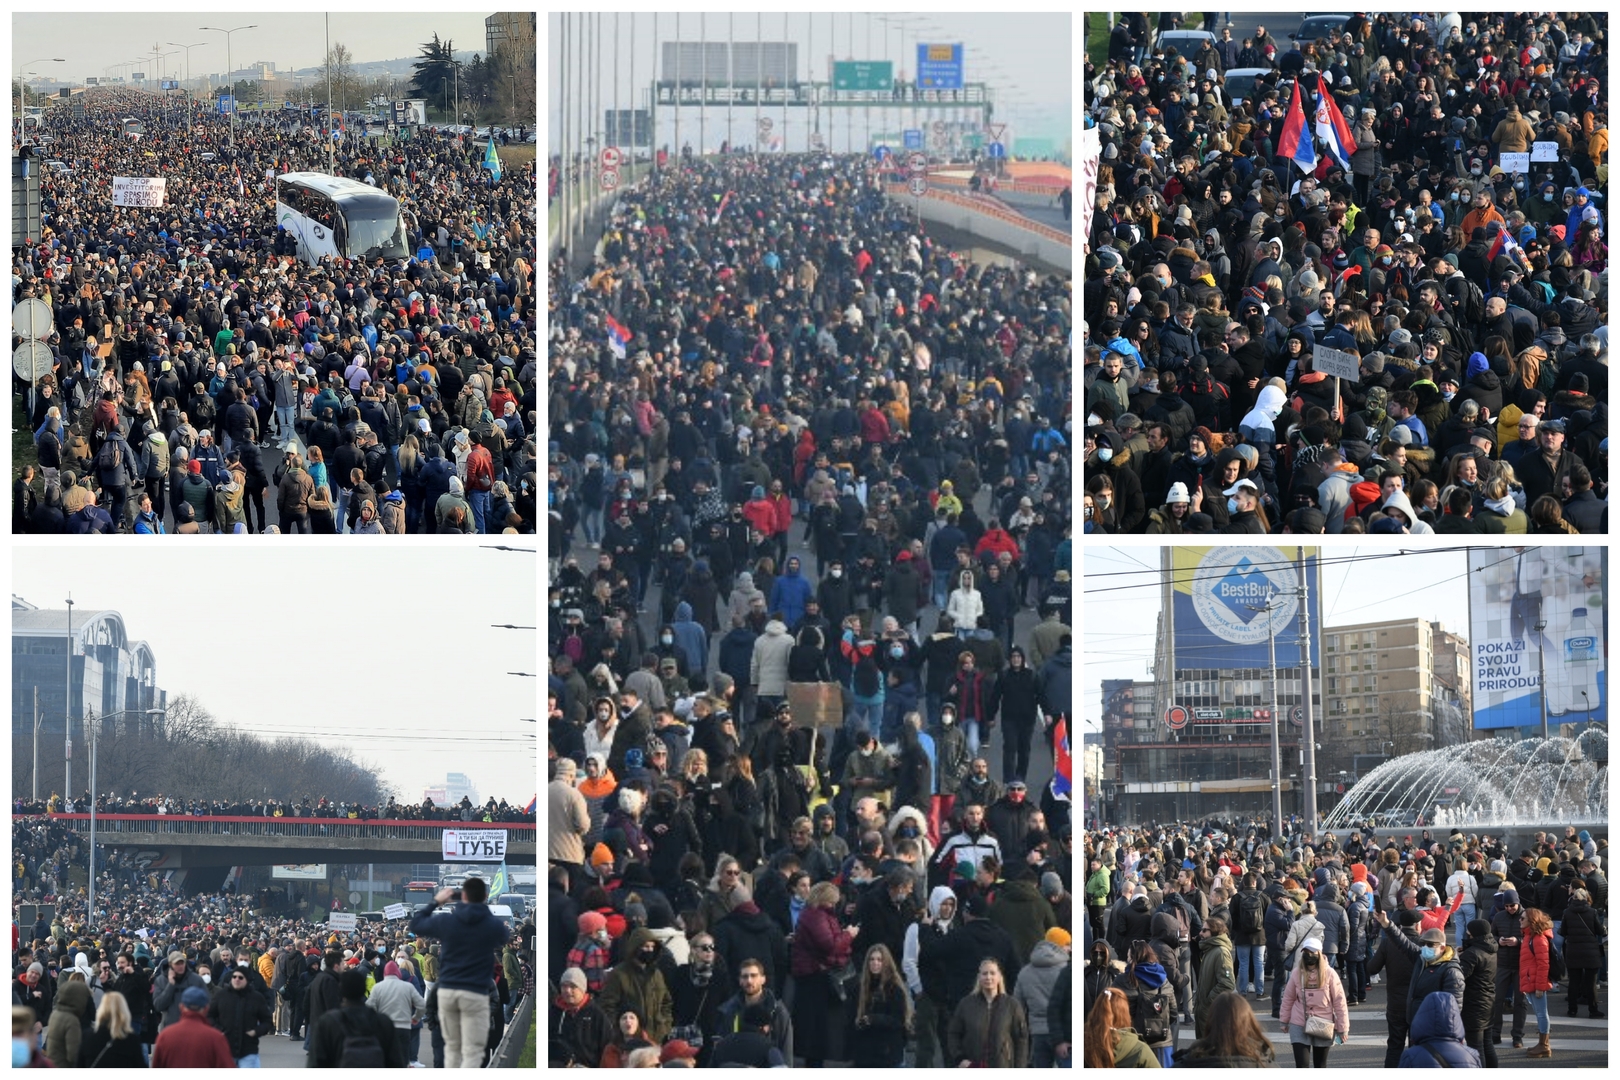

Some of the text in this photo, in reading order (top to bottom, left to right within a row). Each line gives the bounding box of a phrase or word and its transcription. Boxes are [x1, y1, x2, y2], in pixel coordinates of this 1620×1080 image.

[124, 191, 158, 199] SPASIMO
[1221, 582, 1273, 598] BestBuy
[1210, 606, 1230, 628] PRIVATE
[1478, 639, 1526, 654] POKAŽI
[1478, 654, 1518, 666] SVOJU
[1478, 666, 1521, 678] PRAVU
[1478, 676, 1540, 690] PRIRODU!
[459, 840, 504, 856] ТУЂЕ
